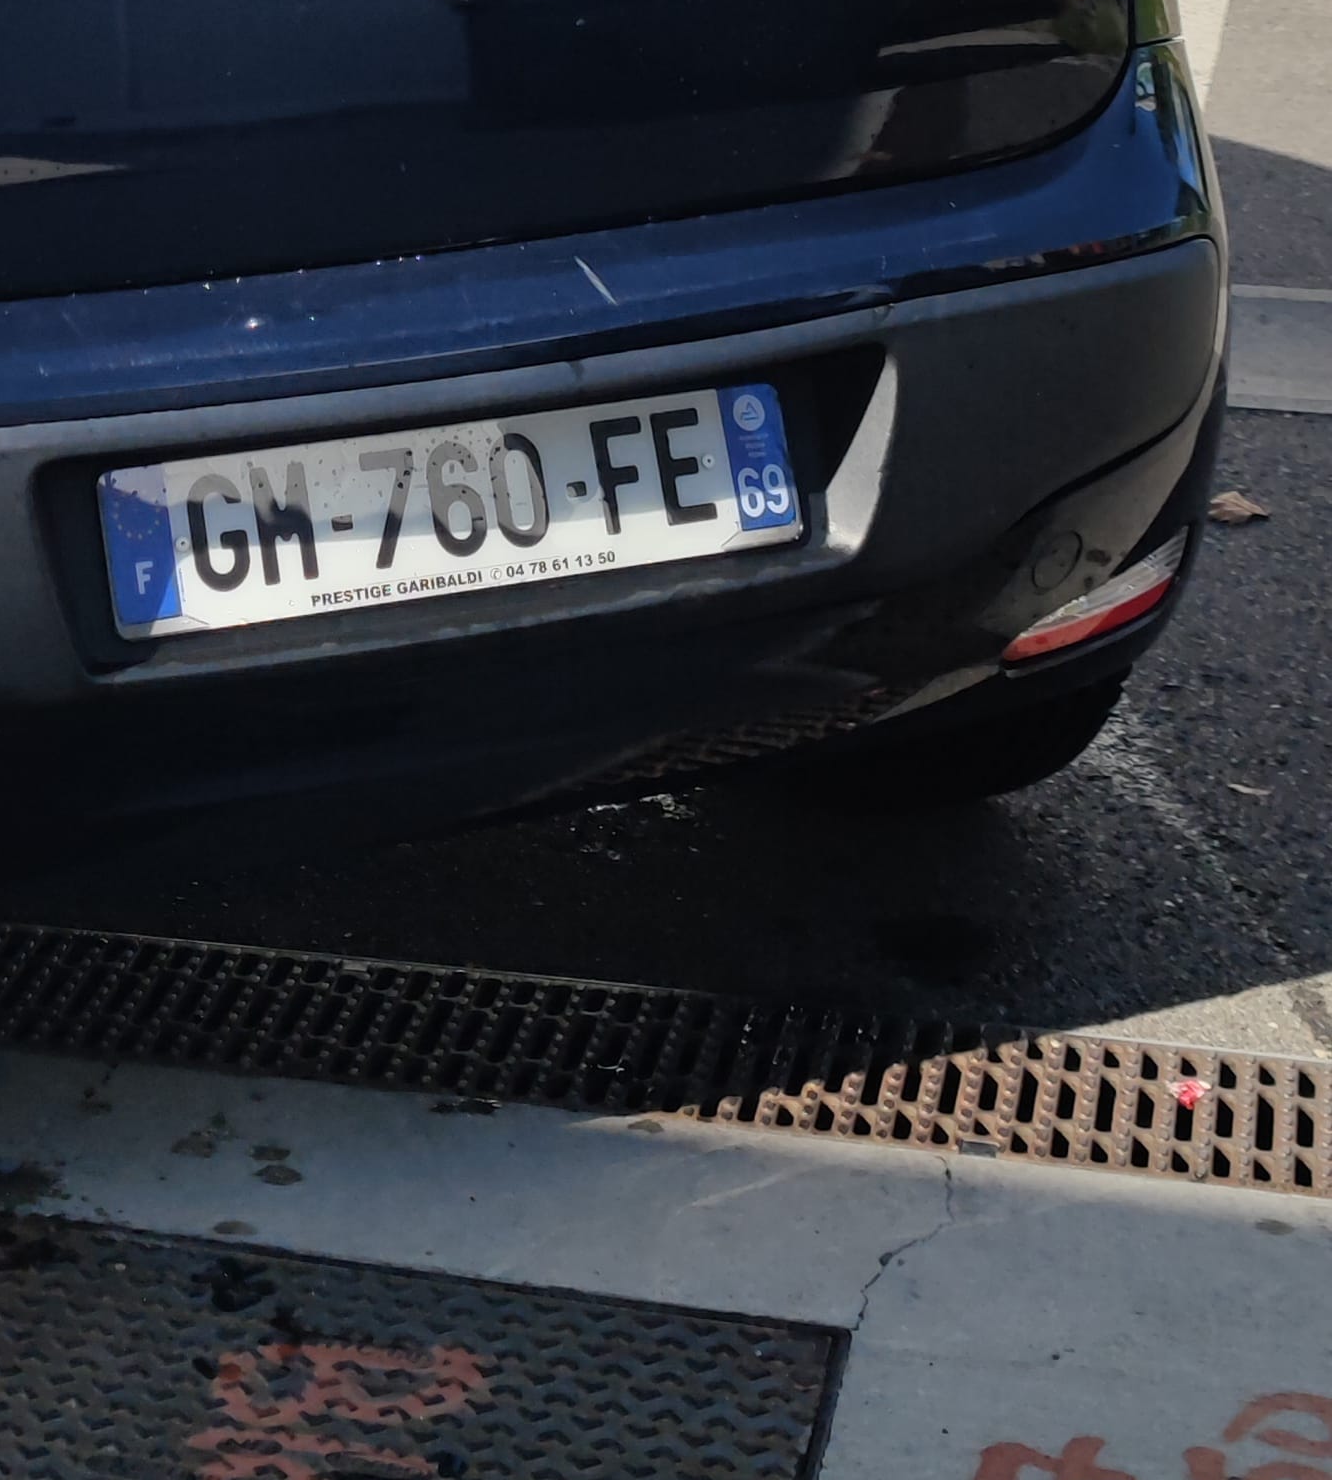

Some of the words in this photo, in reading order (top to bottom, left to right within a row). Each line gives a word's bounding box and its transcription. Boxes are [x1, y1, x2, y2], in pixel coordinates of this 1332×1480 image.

[738, 463, 791, 519] 69
[135, 560, 154, 595] F
[310, 582, 393, 607] PRESTIGE
[396, 571, 483, 597] GARIBALDI
[505, 564, 526, 580] 04
[529, 560, 549, 576] 78
[553, 556, 569, 572] 61
[575, 553, 594, 569] 13
[597, 550, 617, 566] 50
